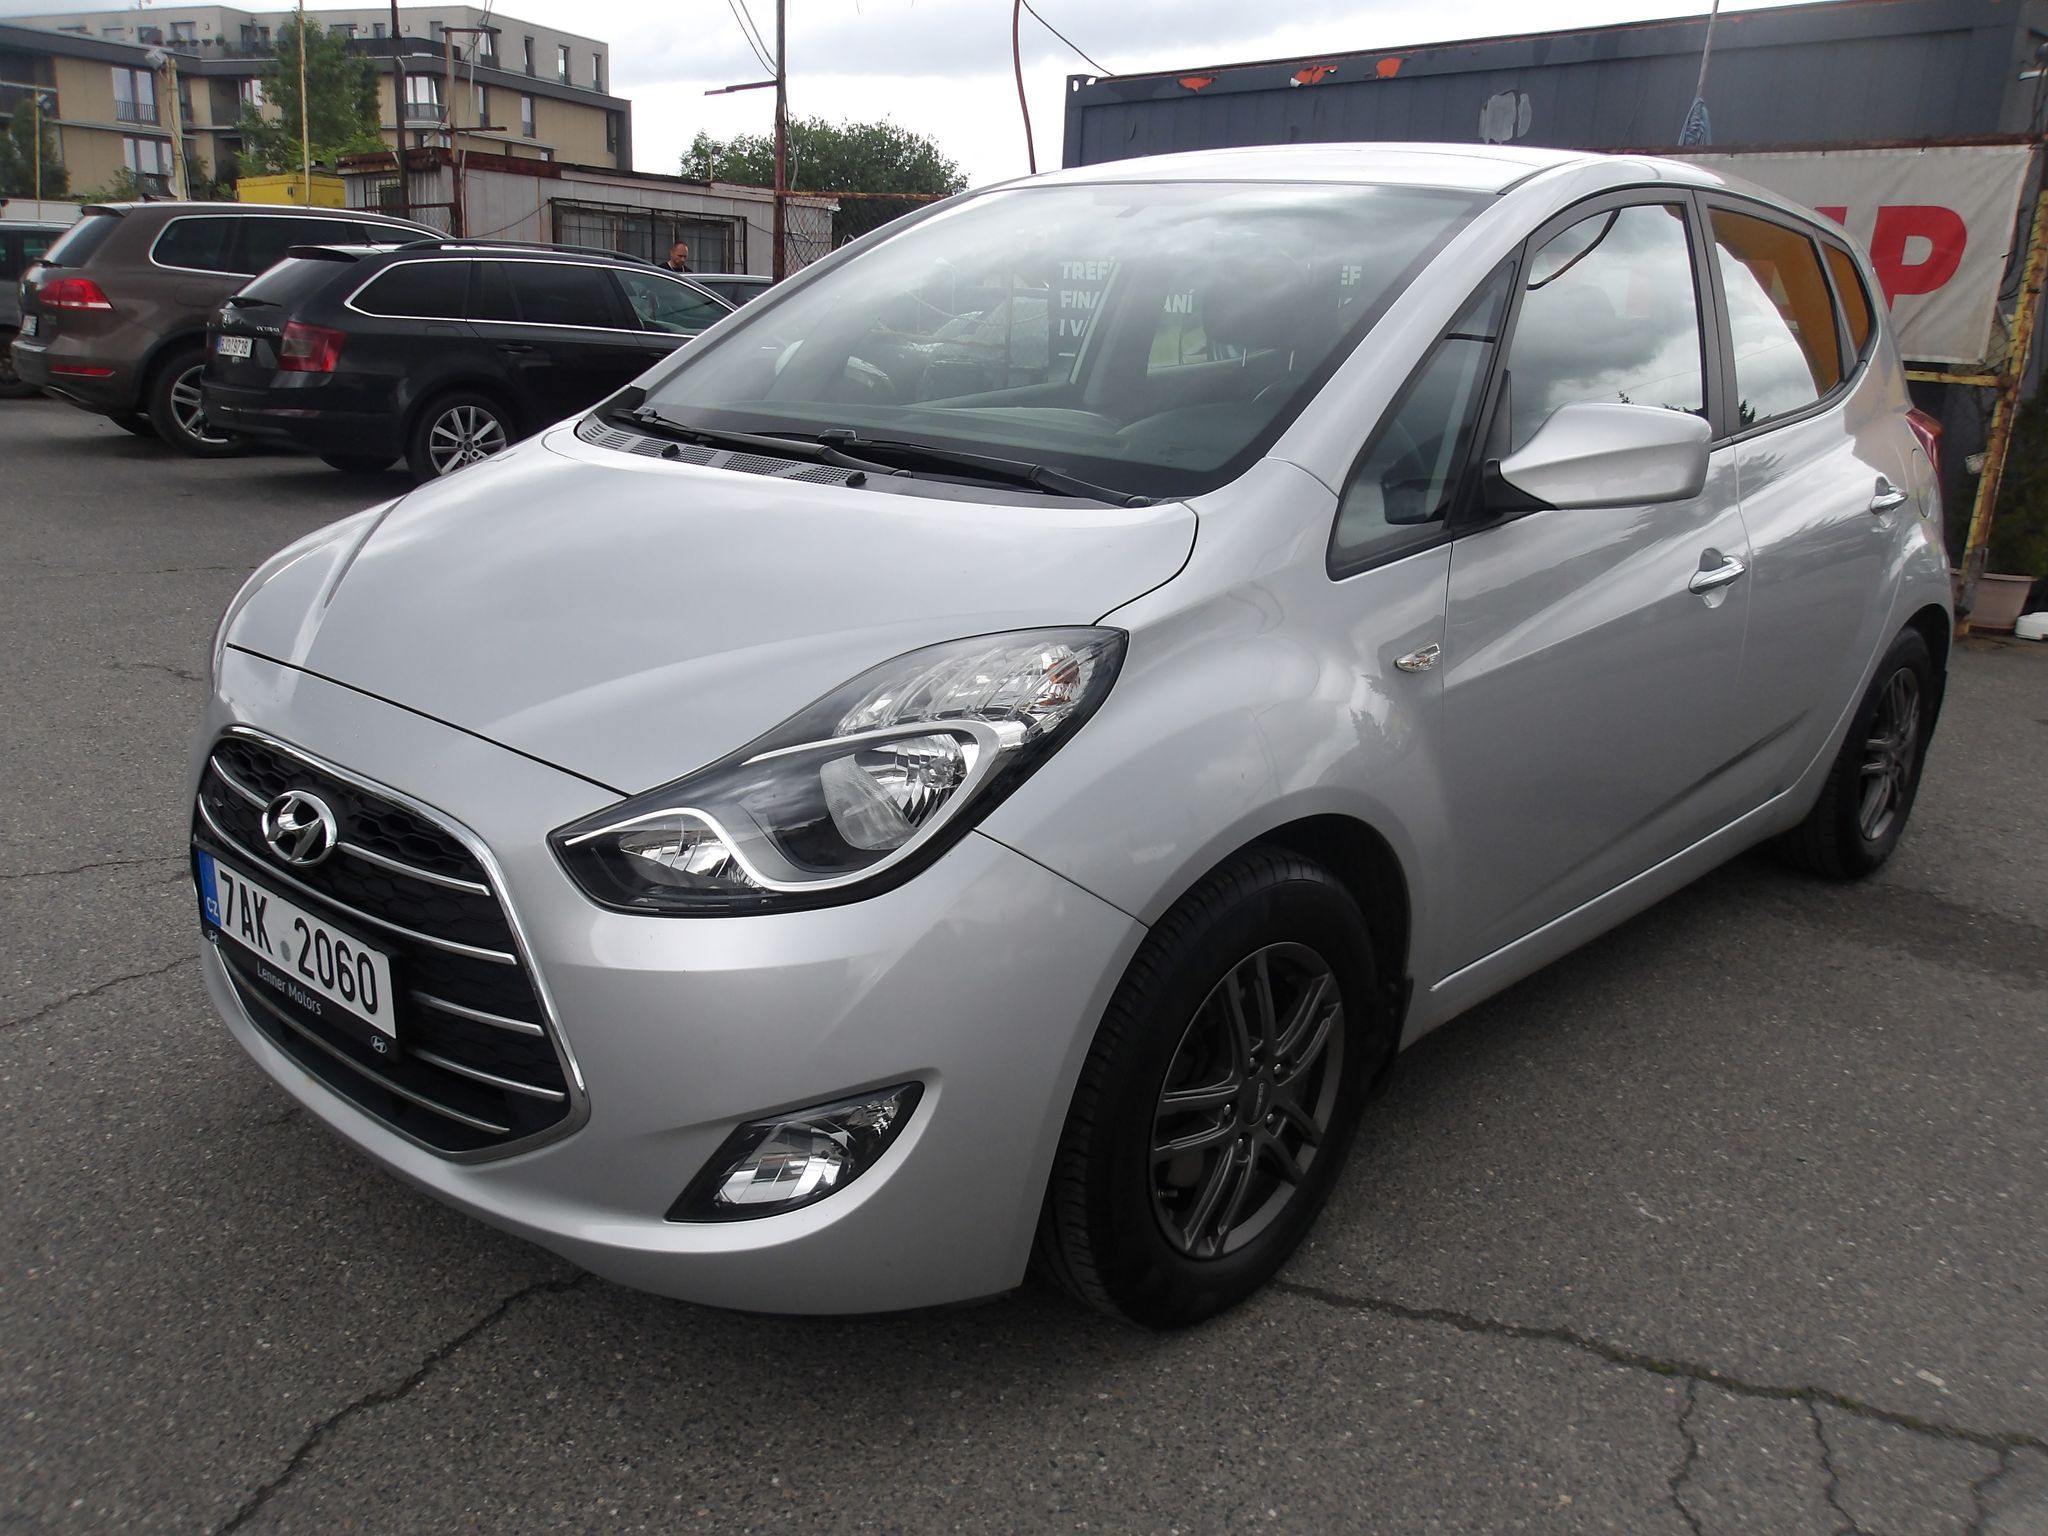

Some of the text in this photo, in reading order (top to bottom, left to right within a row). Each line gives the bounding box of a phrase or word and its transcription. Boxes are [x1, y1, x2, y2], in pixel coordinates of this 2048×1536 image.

[206, 896, 219, 917] CZ
[219, 869, 378, 1015] 7AK 2060
[257, 960, 322, 1015] Lenner Motors
